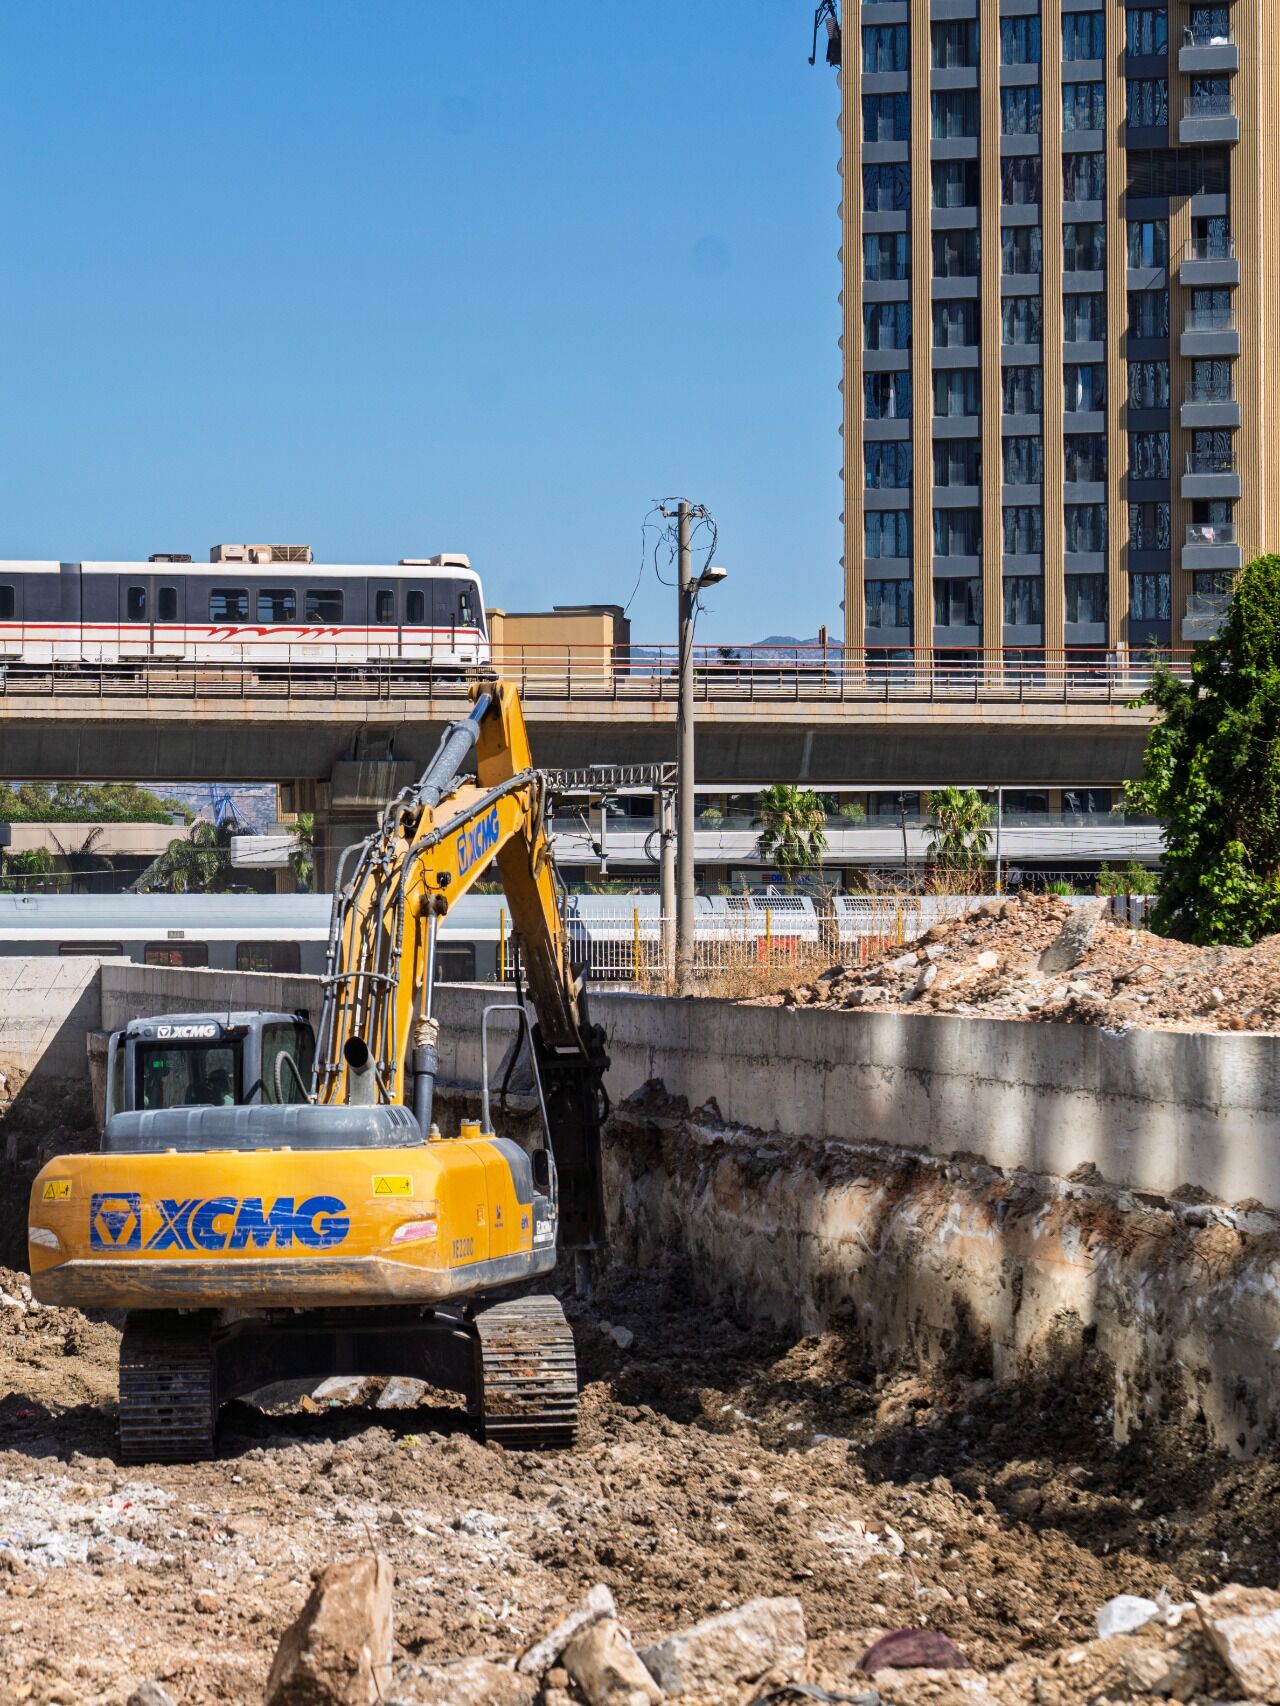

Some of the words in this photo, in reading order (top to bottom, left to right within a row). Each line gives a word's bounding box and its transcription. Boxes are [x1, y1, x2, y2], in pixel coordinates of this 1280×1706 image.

[467, 808, 500, 868] XCMG
[171, 1025, 216, 1038] XCMG
[144, 1196, 351, 1251] XCMG
